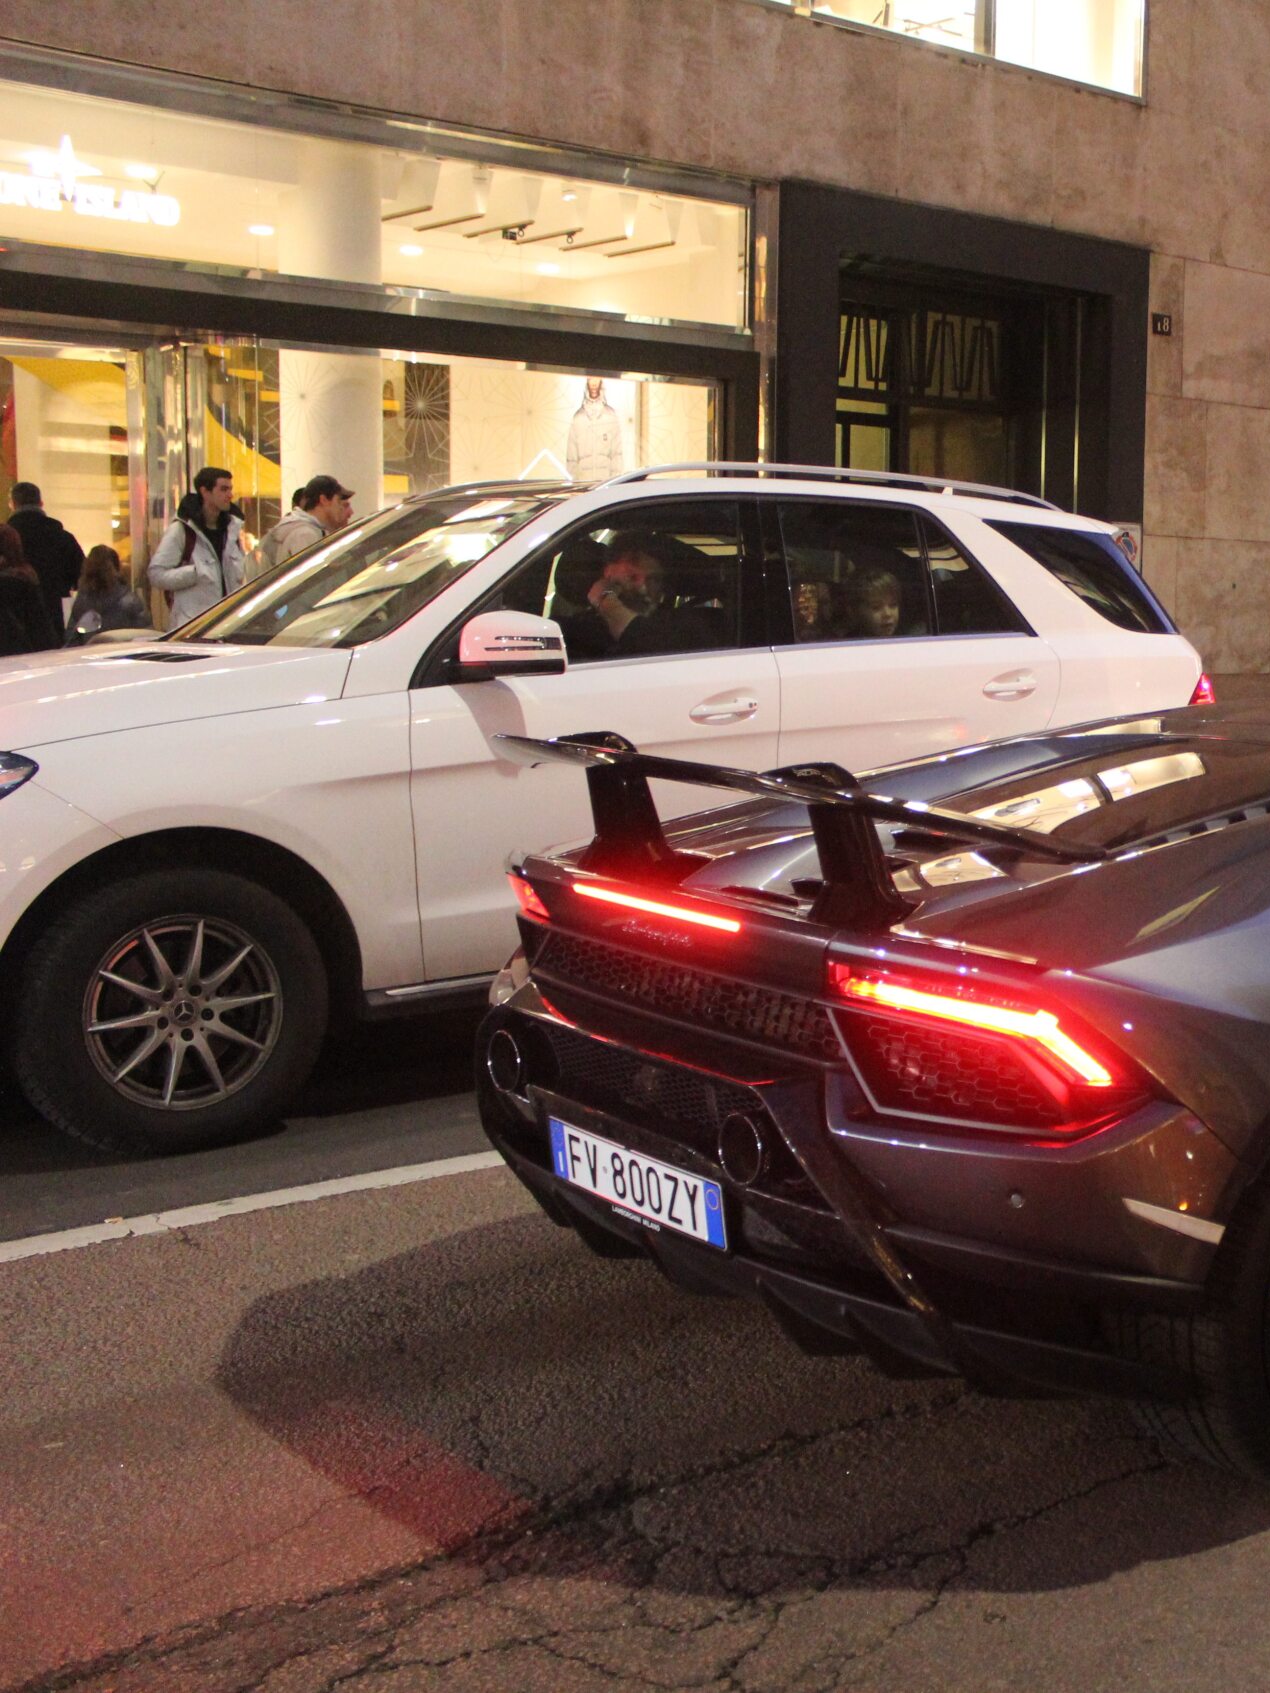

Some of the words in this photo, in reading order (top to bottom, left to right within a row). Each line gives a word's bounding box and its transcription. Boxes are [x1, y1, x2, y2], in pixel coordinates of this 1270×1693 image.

[74, 182, 180, 226] ISLAND
[1157, 317, 1170, 332] 18
[567, 1133, 598, 1189] FV
[611, 1152, 698, 1231] 800ZY
